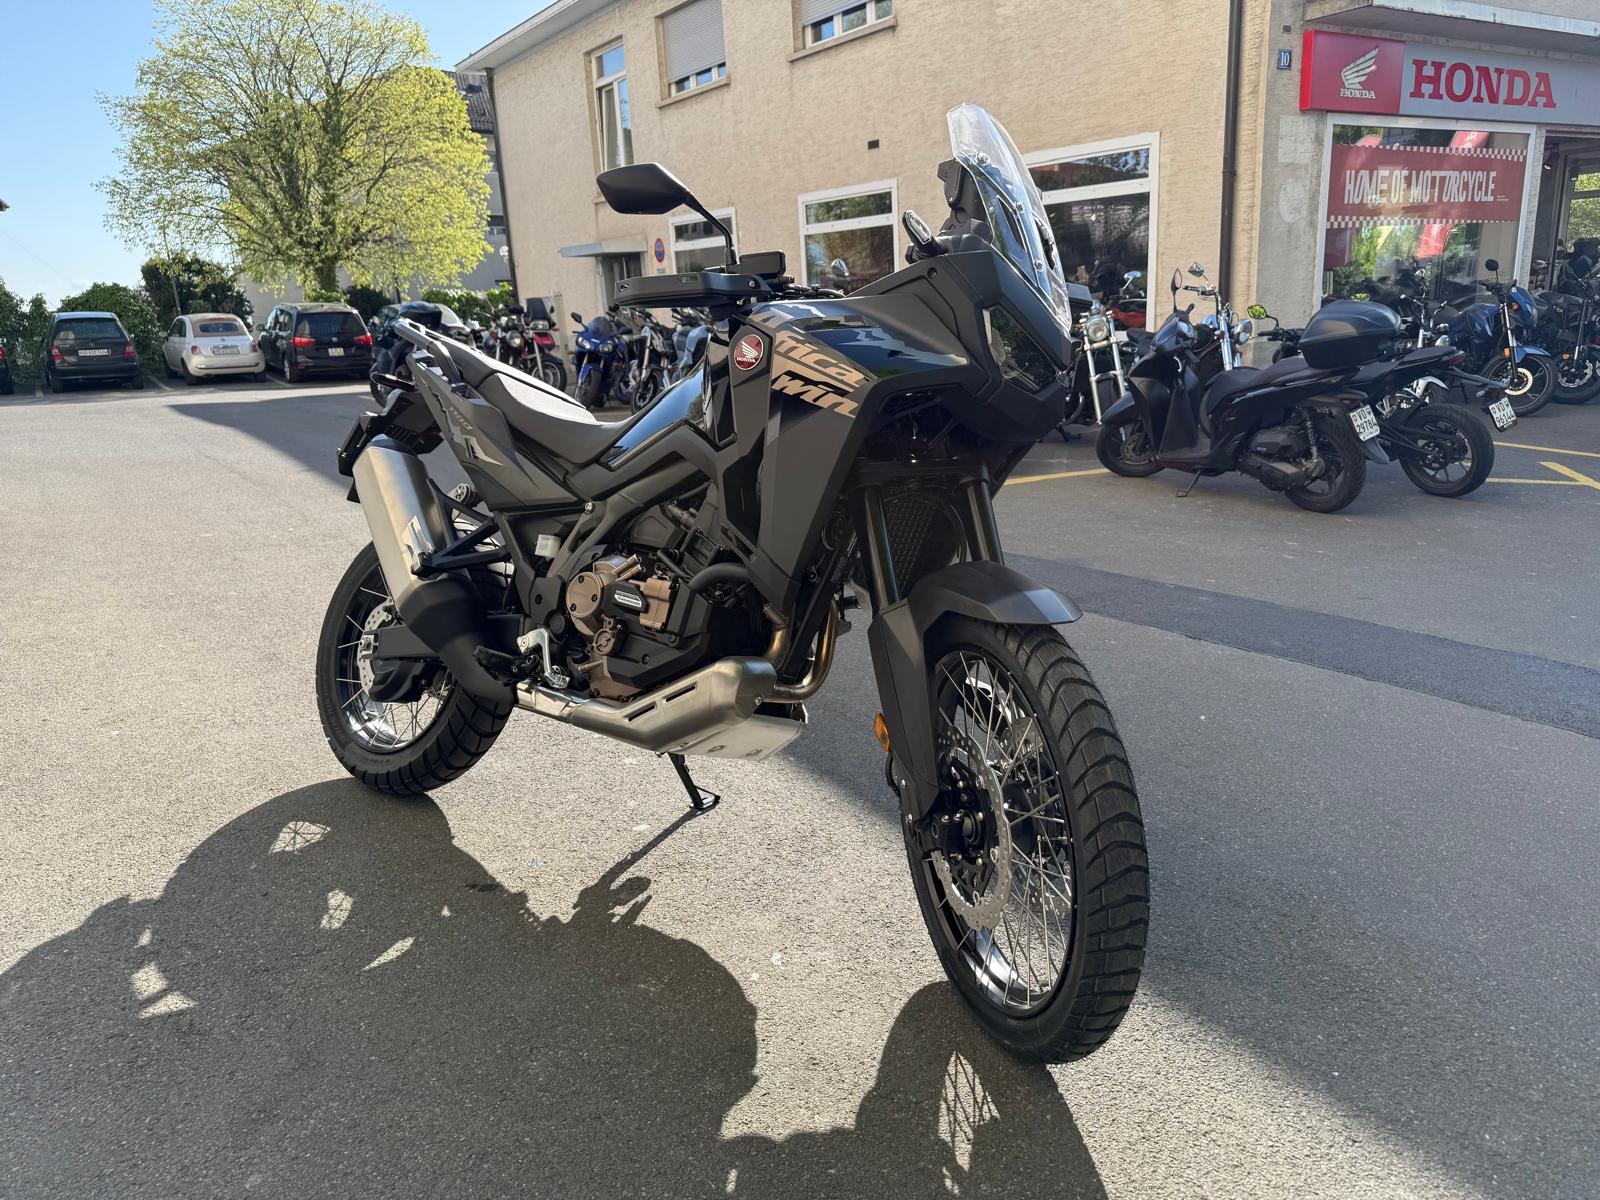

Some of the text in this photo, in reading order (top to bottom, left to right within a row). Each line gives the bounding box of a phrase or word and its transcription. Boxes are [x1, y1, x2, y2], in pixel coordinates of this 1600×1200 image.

[1280, 51, 1290, 66] 10
[1409, 58, 1557, 108] HONDA
[1340, 88, 1376, 99] HONDA
[1344, 169, 1389, 204] HOME
[1390, 170, 1409, 203] OF
[1494, 401, 1506, 413] VD
[1355, 409, 1367, 421] VD
